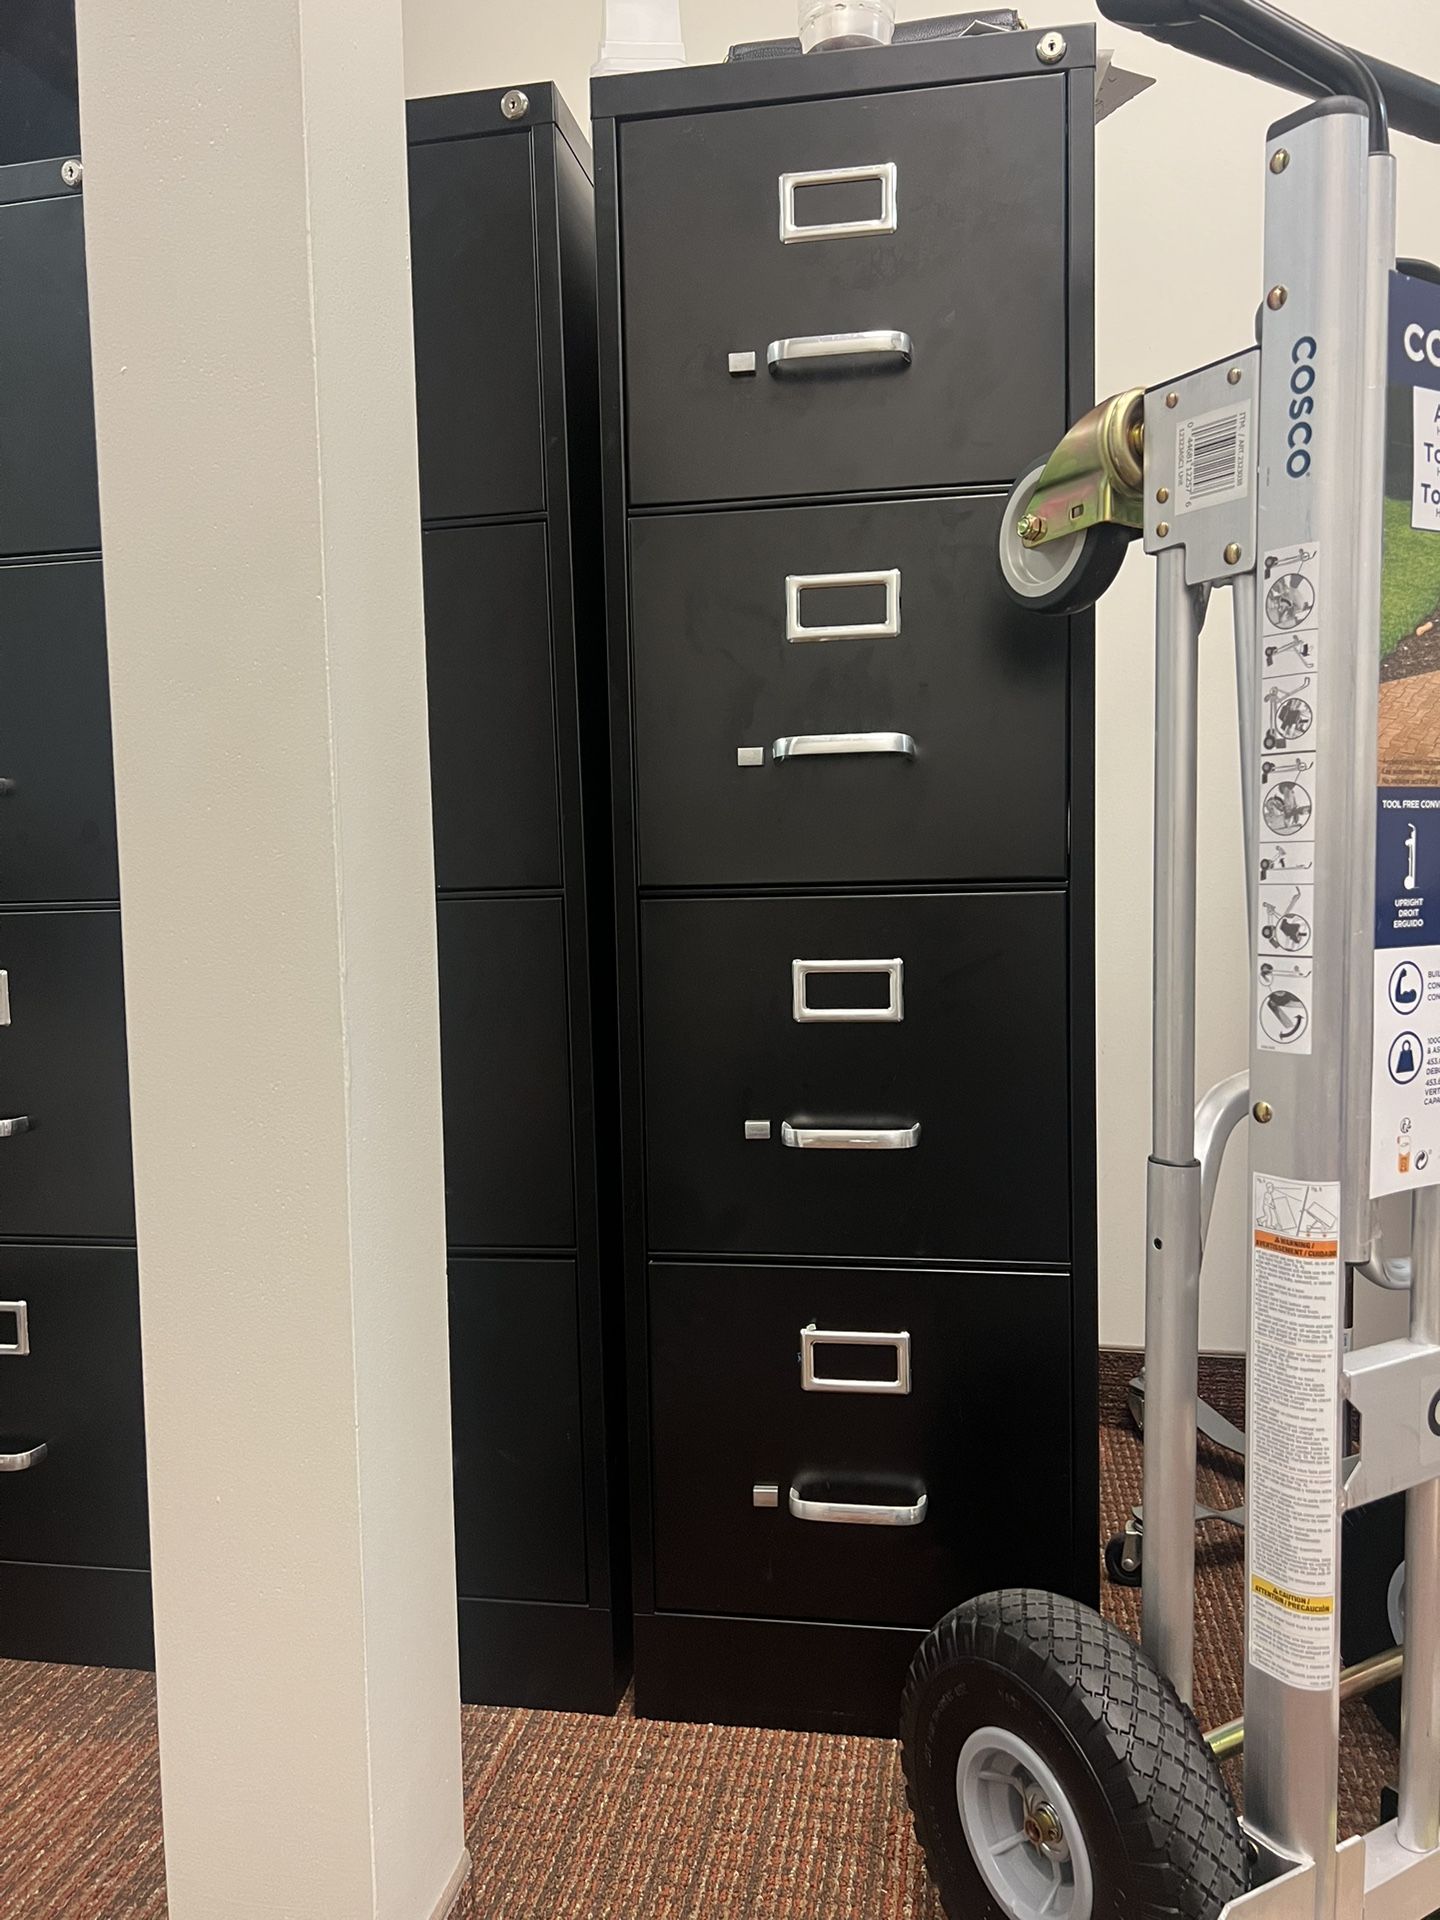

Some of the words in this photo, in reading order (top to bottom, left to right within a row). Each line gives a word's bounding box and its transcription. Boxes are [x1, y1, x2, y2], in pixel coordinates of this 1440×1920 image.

[1286, 336, 1317, 479] COSCO
[1186, 437, 1194, 464] 44681
[1185, 467, 1193, 493] 12257
[1382, 800, 1401, 808] TOOL
[1402, 800, 1420, 808] FREE
[1394, 898, 1424, 907] UPRIGHT
[1398, 909, 1419, 917] DROIT
[1393, 919, 1424, 928] ERGUIDO
